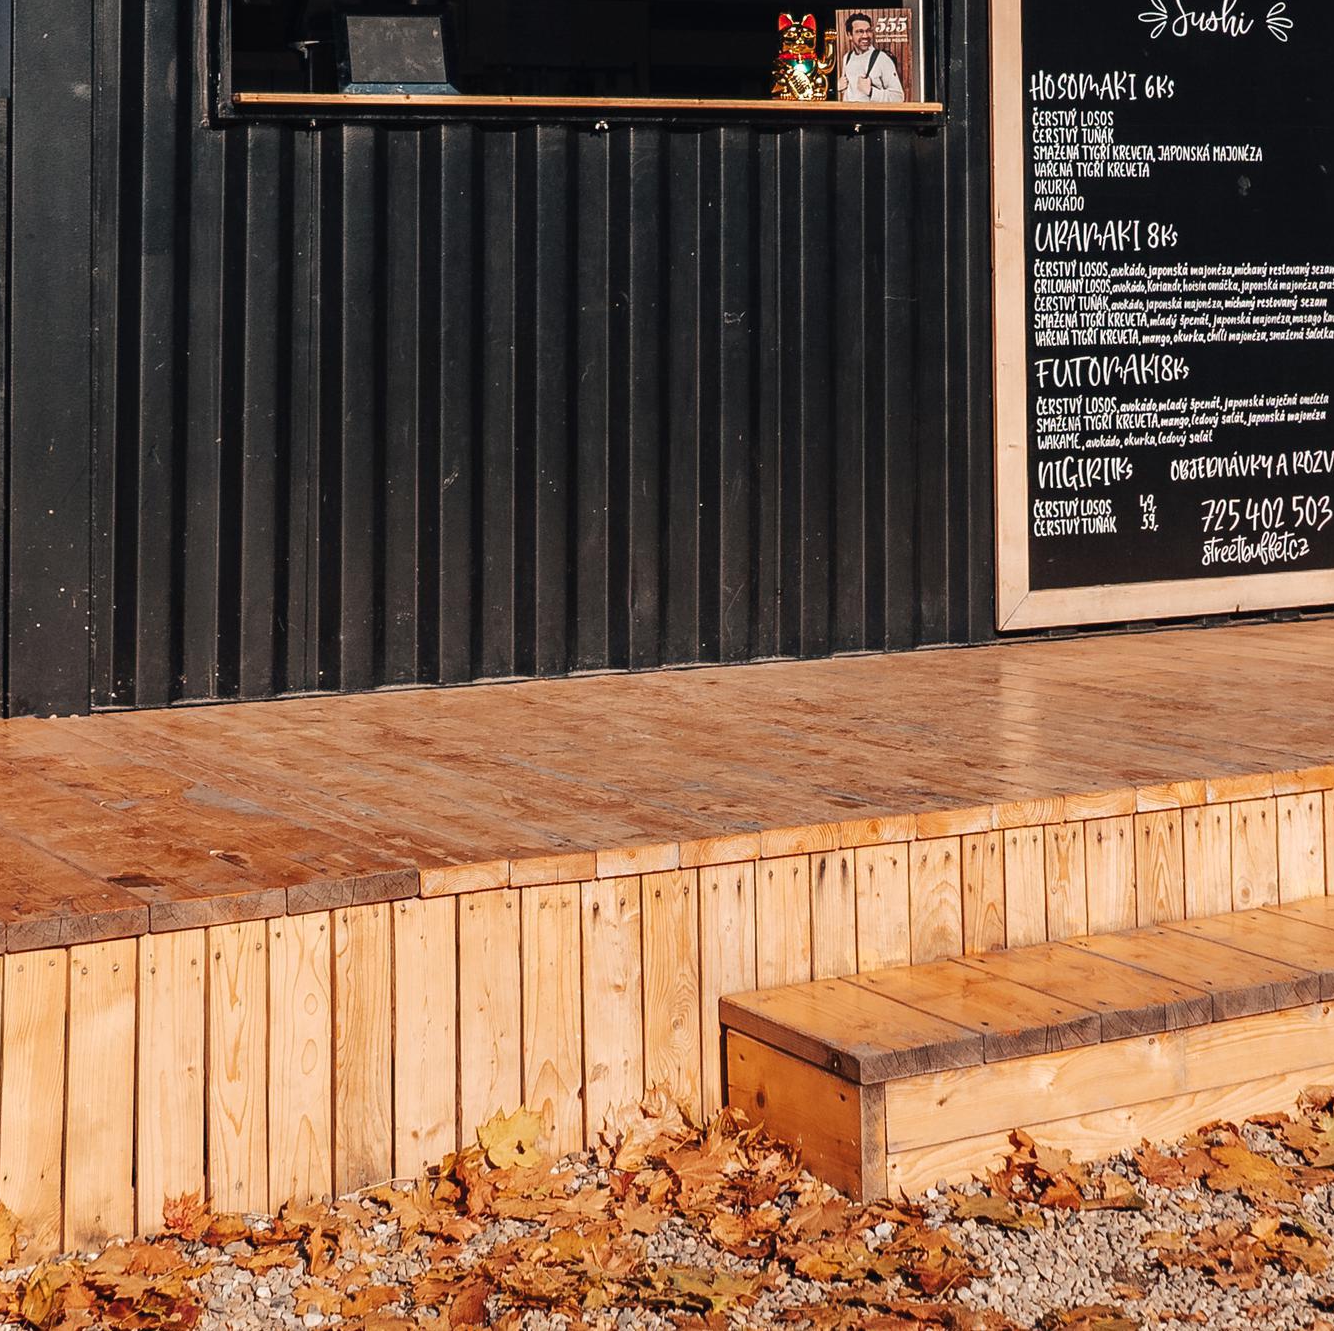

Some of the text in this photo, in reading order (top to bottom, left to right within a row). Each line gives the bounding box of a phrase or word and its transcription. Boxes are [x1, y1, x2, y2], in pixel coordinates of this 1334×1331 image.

[875, 16, 908, 33] 555
[1029, 70, 1138, 102] HOSOMAKI
[1032, 107, 1078, 128] ČERSTVÝ
[1080, 110, 1115, 128] LOSOS
[1032, 126, 1079, 145] ČERSTVÝ
[1081, 126, 1115, 145] TUŇÁK
[1033, 143, 1080, 162] SMAŽENÁ
[1081, 142, 1112, 161] TYGŘÍ
[1113, 145, 1156, 164] KREVETA,
[1157, 143, 1210, 162] JAPONSKÁ
[1213, 143, 1264, 163] MAJONÉZA
[1034, 160, 1075, 178] VAŘENÁ
[1076, 159, 1105, 178] TYGŘÍ
[1107, 162, 1151, 178] KREVETA
[1034, 178, 1078, 196] OKURKA
[1034, 193, 1086, 212] AVOKÁDO
[1034, 220, 1142, 253] URAMAKI
[1033, 258, 1078, 278] ČERSTVÝ
[1033, 277, 1084, 295] GRILOVANÝ
[1033, 293, 1076, 313] ČERSTVÝ
[1033, 311, 1078, 330] SMAŽENÁ
[1079, 311, 1107, 328] TYGŘÍ
[1035, 328, 1069, 347] VAŘENÁ
[1070, 327, 1099, 346] TYGŘÍ
[1034, 352, 1160, 390] FUTOMAKI
[1036, 394, 1084, 416] ČERSTVÝ
[1036, 414, 1082, 434] SMAŽENÁ
[1082, 412, 1113, 432] TYGŘÍ
[1038, 455, 1111, 492] NIGIRI
[1169, 450, 1274, 482] OBJEDNÁVKY
[1033, 495, 1334, 533] ČERSTVÝ LOSOS 725 402 503
[1033, 511, 1118, 538] ČERSTVÝ TUŇÁK
[1201, 530, 1312, 566] streetbuffet.cz
